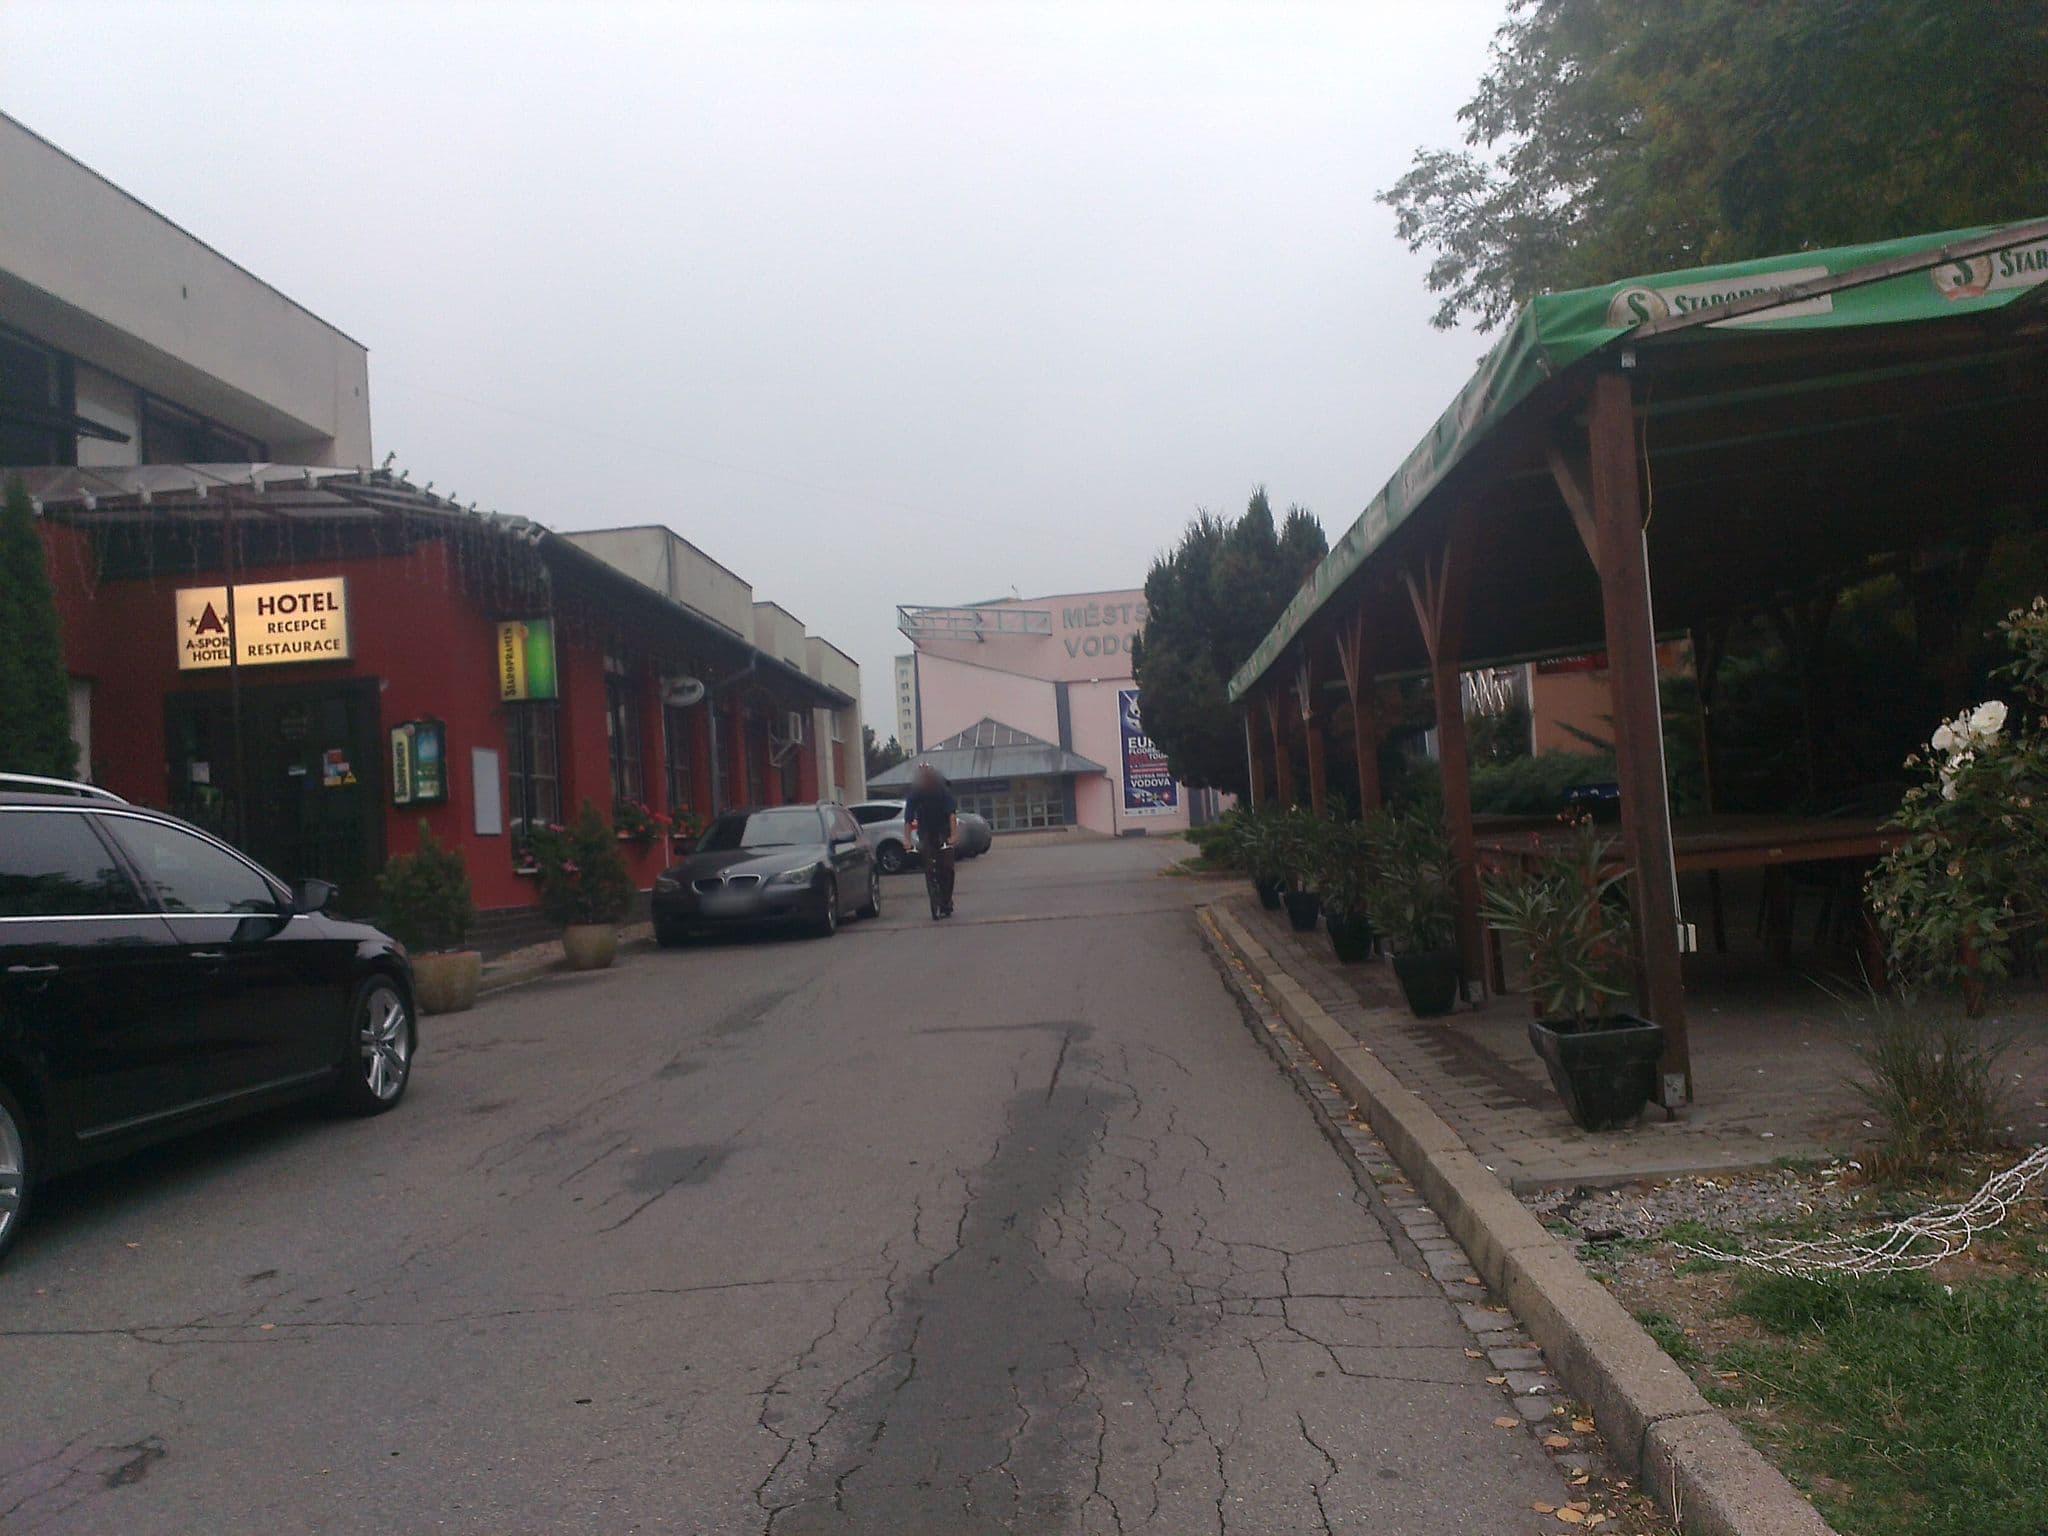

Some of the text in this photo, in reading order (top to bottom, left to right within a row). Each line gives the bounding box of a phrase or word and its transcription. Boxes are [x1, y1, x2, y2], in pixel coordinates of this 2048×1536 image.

[257, 592, 339, 616] HOTEL
[1063, 600, 1148, 629] MĚSTS
[267, 618, 327, 634] RECEPCE
[186, 636, 230, 650] A-SPOR
[248, 638, 341, 657] RESTAURACE
[1063, 632, 1136, 658] VODO
[193, 648, 229, 662] HOTEL
[1128, 735, 1157, 749] EUR
[1130, 777, 1171, 788] VODOVA
